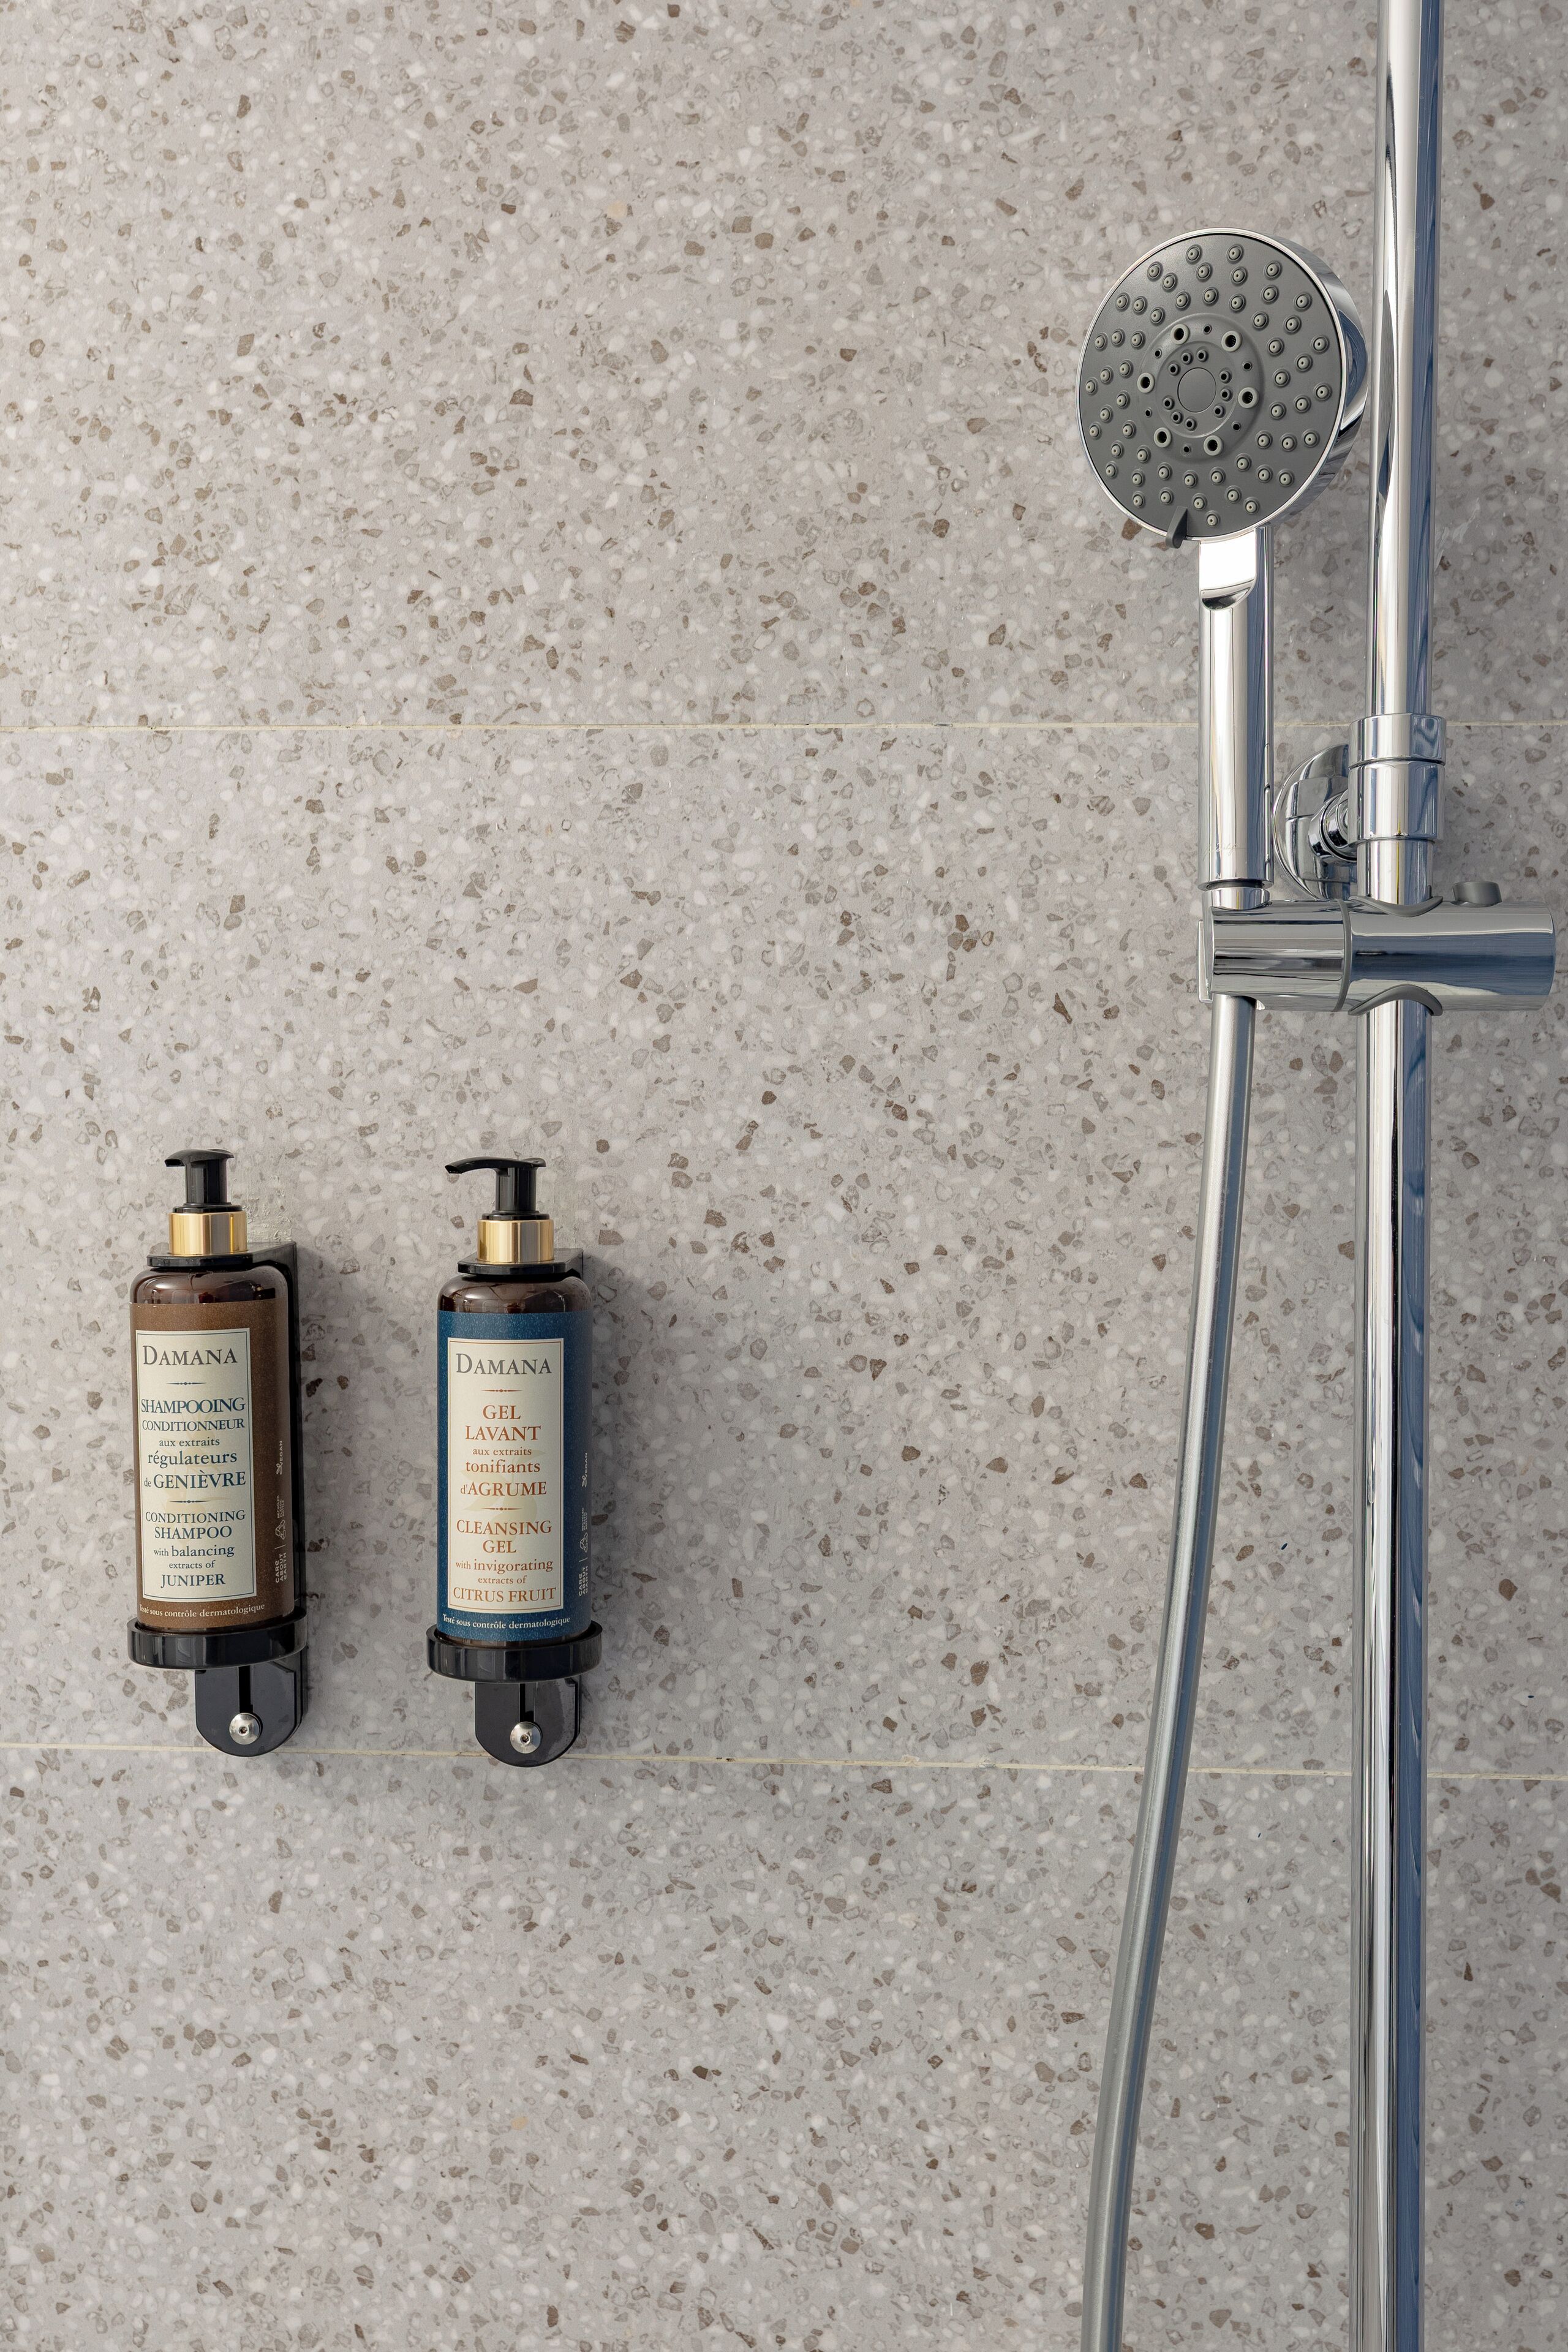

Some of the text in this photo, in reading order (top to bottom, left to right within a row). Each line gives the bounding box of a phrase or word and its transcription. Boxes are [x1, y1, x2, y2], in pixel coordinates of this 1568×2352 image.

[143, 1345, 238, 1365] DAMANA
[456, 1353, 552, 1375] DAMANA
[141, 1397, 246, 1414] SHAMPOOING
[483, 1405, 521, 1420] GEL
[142, 1418, 245, 1431] CONDITIONNEUR
[465, 1425, 541, 1441] LAVANT
[179, 1436, 220, 1447] extraits
[493, 1446, 532, 1456] extraits
[148, 1450, 237, 1469] régulateurs
[466, 1459, 540, 1474] tonifiants
[144, 1470, 246, 1489] de GENIÈVRE
[460, 1481, 547, 1496] d'AGRUME
[145, 1509, 246, 1524] CONDITIONING
[154, 1525, 232, 1539] SHAMPOO
[456, 1520, 552, 1536] CLEANSING
[172, 1545, 235, 1558] balancing
[483, 1540, 517, 1553] GEL
[205, 1560, 216, 1569] of
[455, 1559, 553, 1574] with invigorating
[160, 1574, 225, 1588] JUNIPER
[516, 1575, 527, 1584] of
[453, 1587, 556, 1602] CITRUS FRUIT
[164, 1609, 197, 1618] contrôle
[199, 1603, 265, 1618] dermatologique
[443, 1613, 455, 1624] Testé
[472, 1620, 506, 1629] contrôle
[508, 1616, 570, 1629] dermatologique
